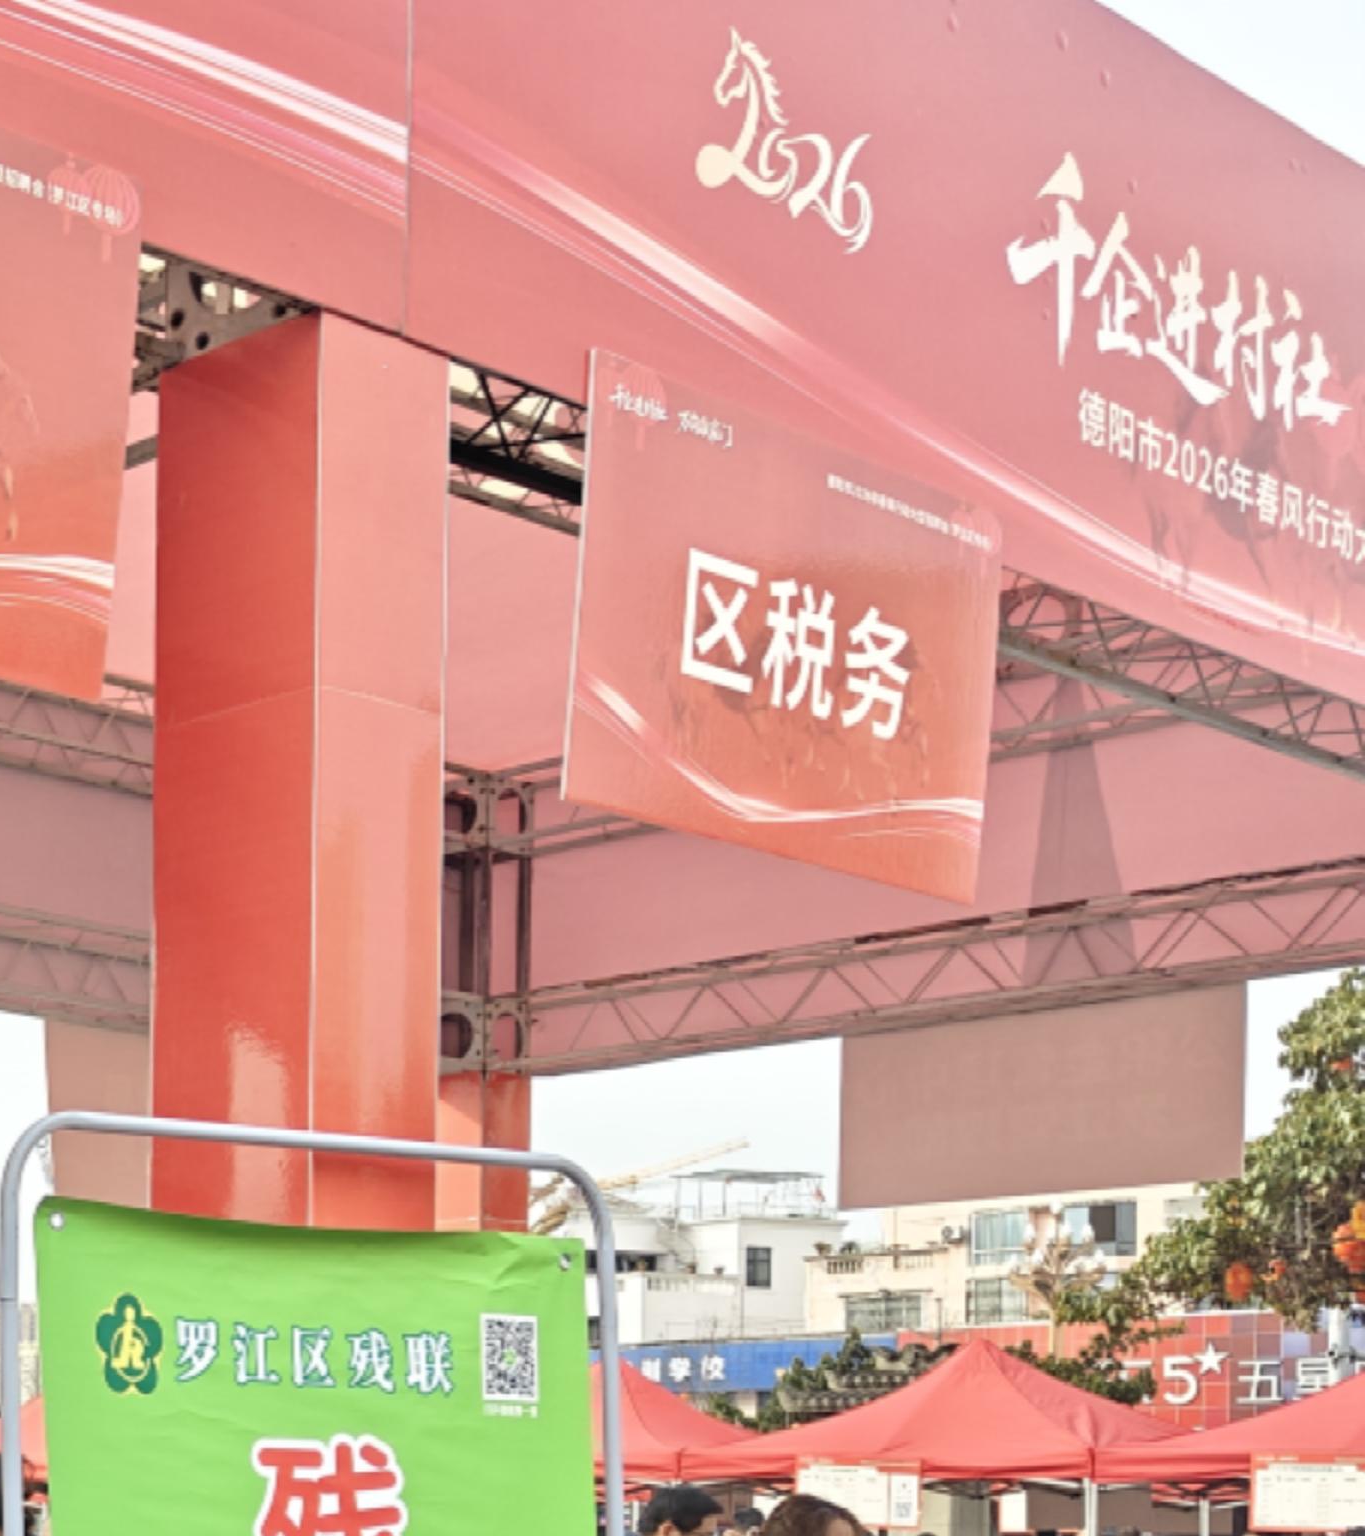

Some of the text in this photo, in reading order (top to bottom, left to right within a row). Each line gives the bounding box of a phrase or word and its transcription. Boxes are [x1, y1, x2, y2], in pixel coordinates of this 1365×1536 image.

[1006, 151, 1352, 432] 千企进村社
[680, 547, 912, 740] 区税务
[174, 1316, 454, 1394] 罗江区残联
